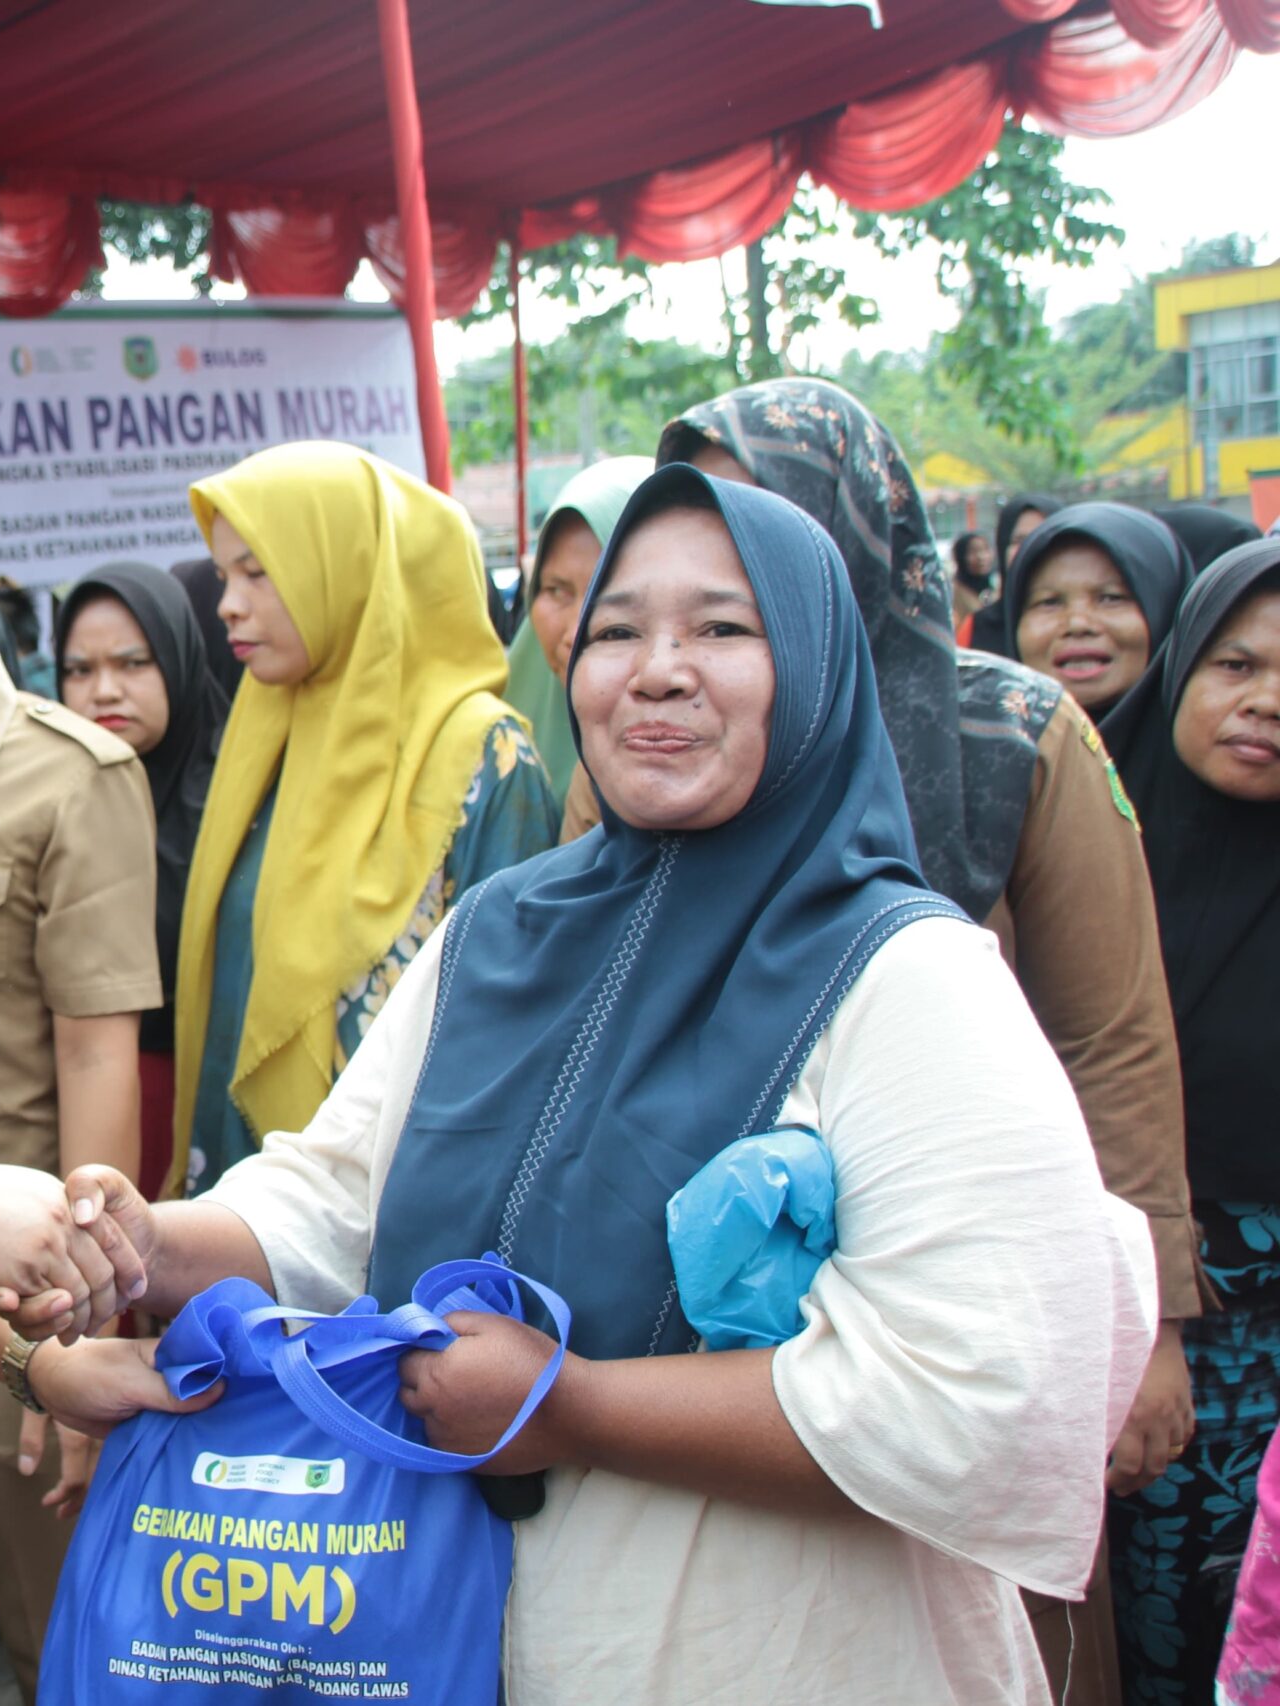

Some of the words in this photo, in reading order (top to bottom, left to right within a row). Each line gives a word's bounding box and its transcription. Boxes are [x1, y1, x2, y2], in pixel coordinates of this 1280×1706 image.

[88, 391, 266, 450] PANGAN
[275, 385, 410, 441] MURAH
[132, 1504, 216, 1543] GERAKAN
[219, 1515, 320, 1554] PANGAN
[325, 1519, 406, 1556] MURAH
[161, 1549, 357, 1635] (GPM)
[131, 1640, 167, 1661] BADAN
[169, 1646, 219, 1665] PANGAN
[222, 1652, 285, 1672] NASIONAL
[287, 1658, 356, 1679] (BAPANAS)
[359, 1662, 388, 1677] DAN
[194, 1629, 278, 1651] Diselenggarakan
[280, 1642, 305, 1655] Oleh
[108, 1658, 146, 1679] DINAS
[148, 1664, 220, 1685] KETAHANAN
[223, 1669, 273, 1689] PANGAN
[276, 1673, 307, 1687] KAB.
[308, 1679, 360, 1696] PADANG
[363, 1681, 409, 1698] LAWAS
